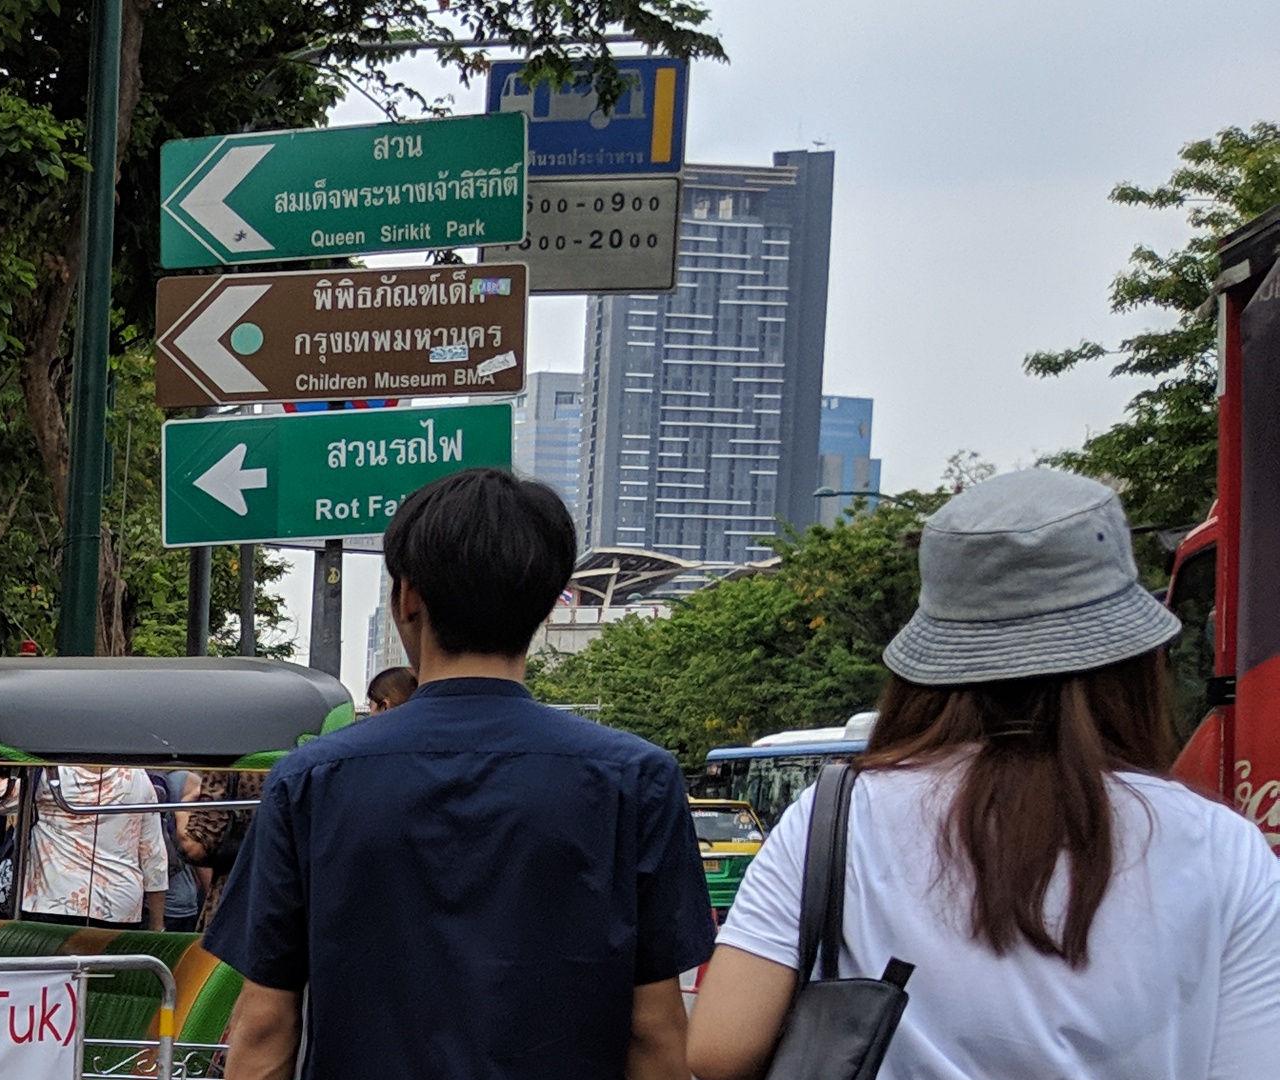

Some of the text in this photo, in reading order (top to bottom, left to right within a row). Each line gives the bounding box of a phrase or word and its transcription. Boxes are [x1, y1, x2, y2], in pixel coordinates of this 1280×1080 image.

[373, 134, 423, 160] สวน
[274, 162, 522, 213] สมเด็จพระนางเจ้าสิริกิติ์
[311, 219, 485, 247] Queen Sirikit Park
[295, 325, 502, 364] กรุงเทพมหานคร
[295, 373, 368, 391] Children
[374, 371, 447, 389] Museum
[327, 418, 463, 468] สวนรถไฟ
[315, 498, 360, 521] Rot
